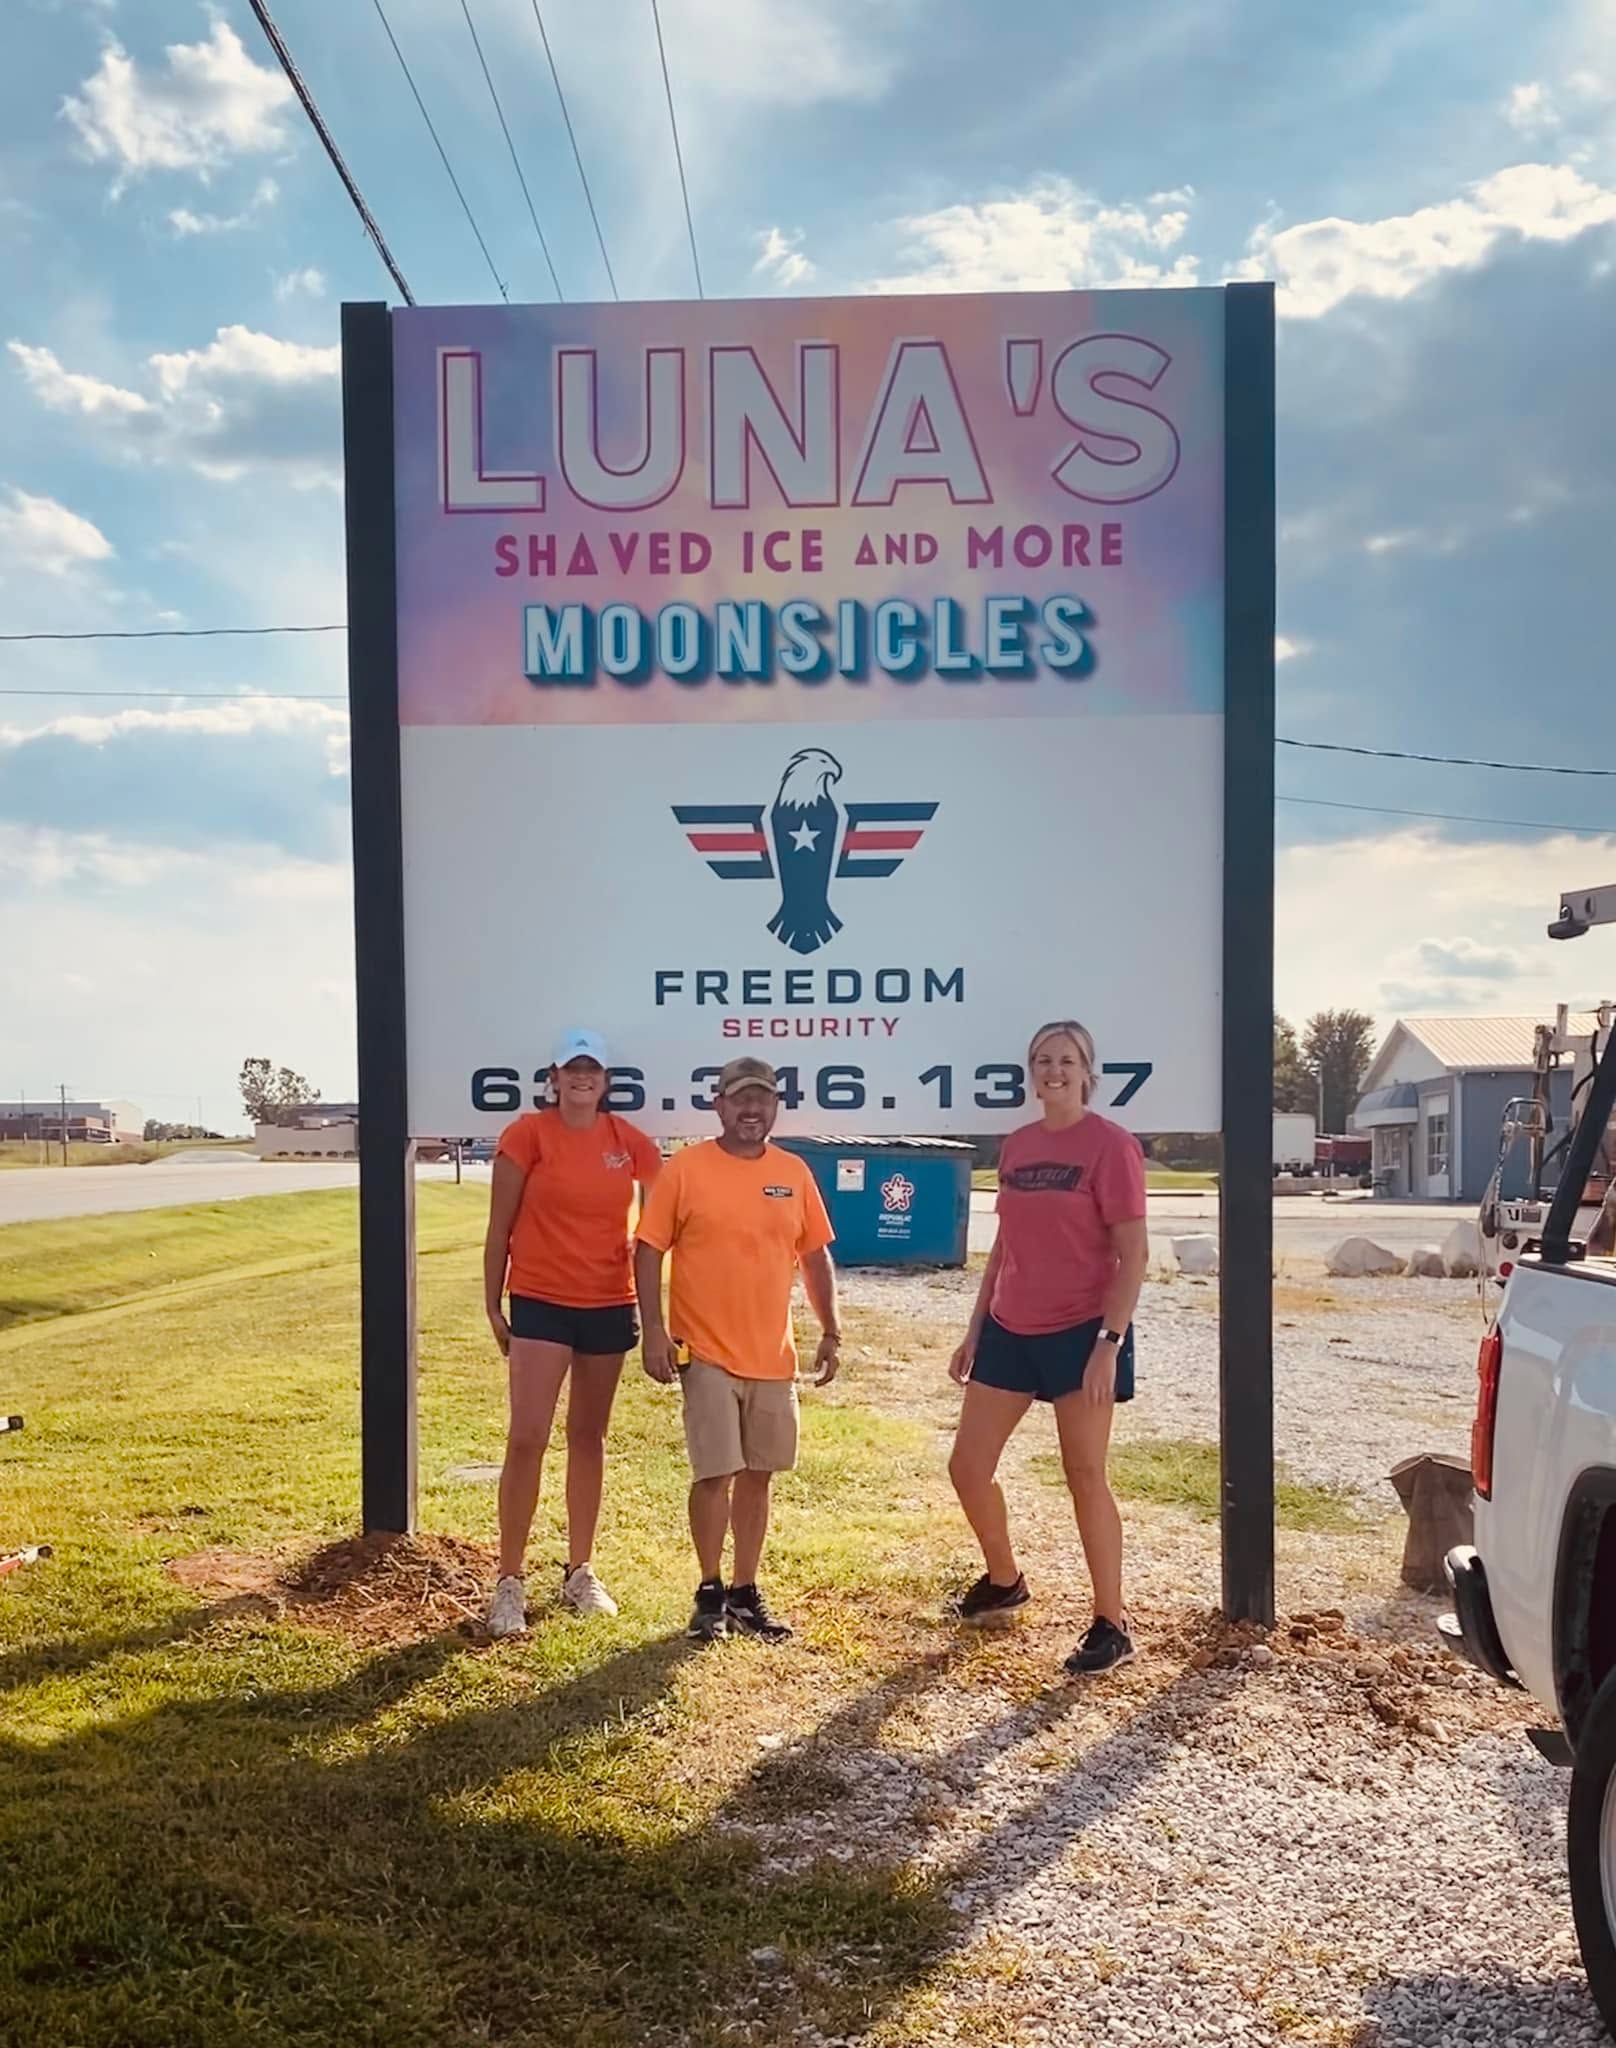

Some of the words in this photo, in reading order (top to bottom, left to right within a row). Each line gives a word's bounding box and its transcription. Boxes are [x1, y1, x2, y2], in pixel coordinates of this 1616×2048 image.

[438, 333, 1182, 514] LUNA'S
[495, 531, 712, 577] SHAVED
[743, 529, 823, 574] ICE
[855, 533, 939, 566] AND
[967, 523, 1124, 569] MORE
[522, 594, 1094, 682] MOONSICLES
[655, 967, 965, 1006] FREEDOM
[722, 1017, 900, 1038] SECURITY
[471, 1060, 1153, 1112] 636.346.137
